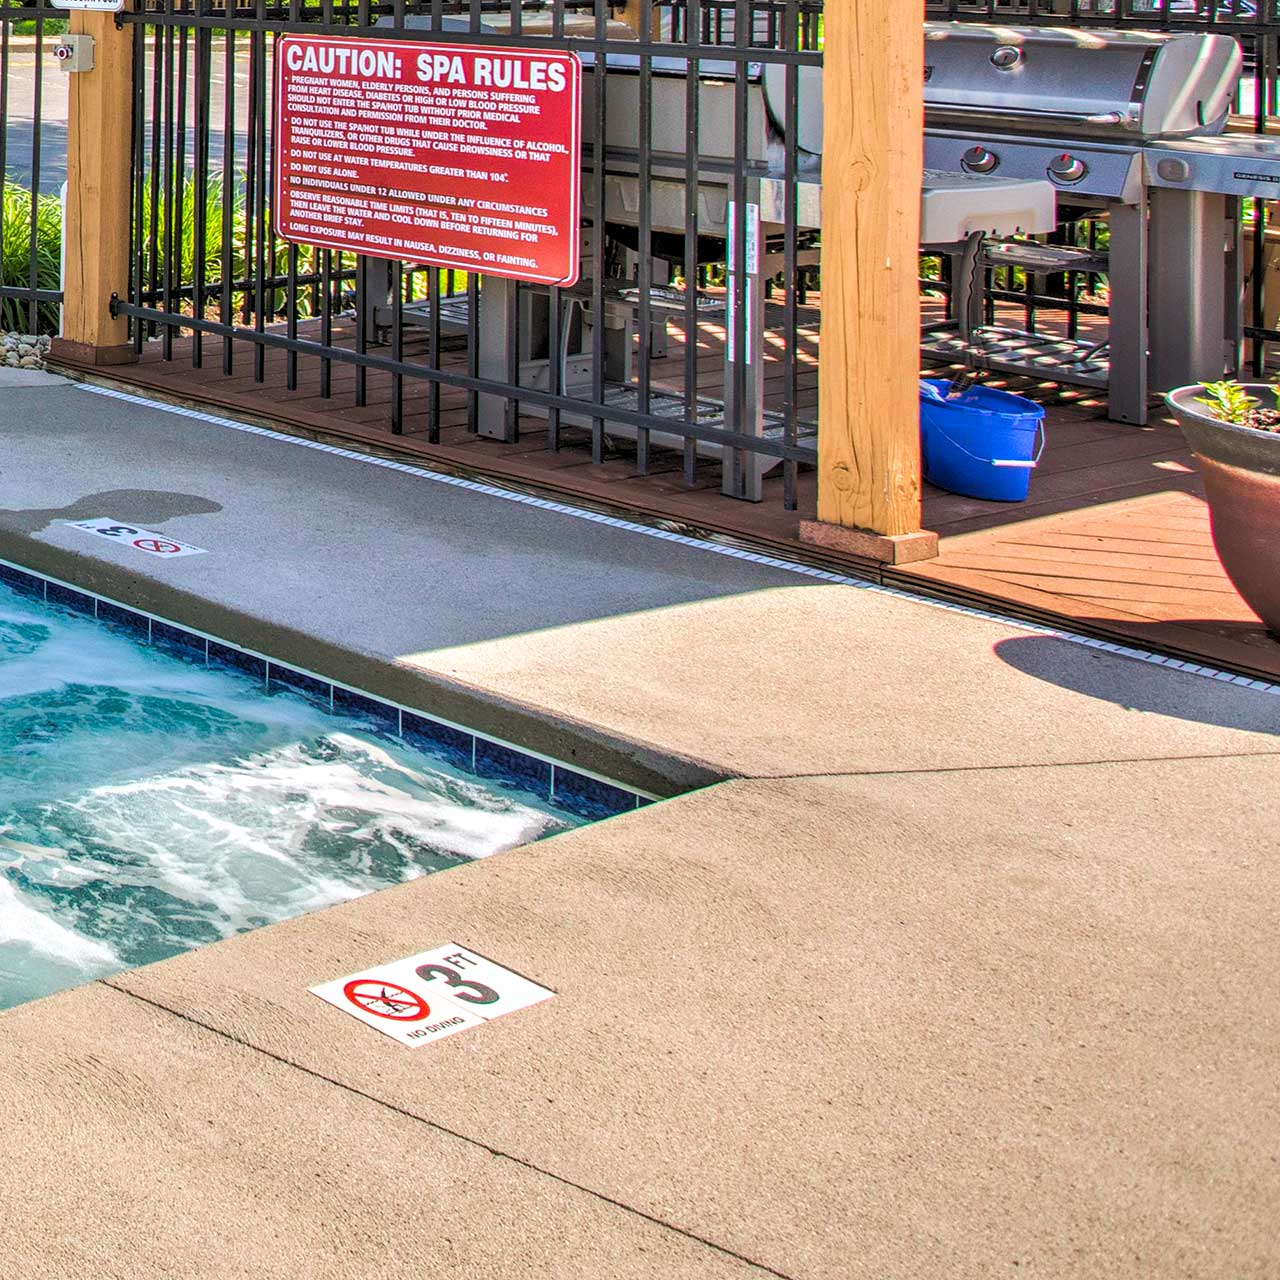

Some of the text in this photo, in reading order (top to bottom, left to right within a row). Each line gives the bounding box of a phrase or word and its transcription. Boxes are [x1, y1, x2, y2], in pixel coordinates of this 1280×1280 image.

[287, 45, 566, 92] CAUTION: SPA RULES
[288, 85, 307, 93] FROM
[310, 87, 331, 95] HEART
[333, 89, 364, 99] DISEASE,
[366, 92, 400, 101] DIABETES
[415, 96, 433, 104] HIGH
[436, 98, 447, 106] OR
[449, 99, 466, 107] LOW
[469, 101, 496, 110] BLOOD
[498, 103, 540, 114] PRESSURE
[292, 76, 535, 103] PREGNANT WOMEN, ELDERLY PERSONS, AND PERSONS SUFFERING
[288, 95, 315, 103] SHOULD
[317, 97, 331, 105] NOT
[333, 99, 355, 107] ENTER
[372, 102, 403, 111] SPA/HOT
[405, 105, 419, 113] TUB
[421, 106, 456, 116] WITHOUT
[458, 110, 481, 119] PRIOR
[483, 112, 520, 122] MEDICAL
[288, 104, 488, 130] CONSULTATION AND PERMISSION FROM THEIR DOCTOR.
[291, 127, 345, 141] TRANQUILIZERS,
[359, 134, 383, 143] OTHER
[385, 136, 410, 146] DRUGS
[412, 139, 431, 148] THAT
[433, 141, 458, 151] CAUSE
[460, 144, 513, 157] DROWSINESS
[515, 150, 527, 159] OR
[529, 151, 550, 161] THAT
[291, 136, 415, 156] RAISE OR LOWER BLOOD PRESSURE.
[319, 120, 332, 128] USE
[335, 122, 347, 130] THE
[349, 123, 378, 133] SPA/HOT
[381, 127, 395, 135] TUB
[397, 128, 420, 137] WHILE
[422, 131, 448, 140] UNDER
[450, 133, 465, 142] THE
[467, 135, 511, 147] INFLUENCE
[513, 140, 525, 148] OF
[526, 141, 568, 154] ALCOHOL,
[291, 163, 359, 178] DO NOT USE ALONE.
[303, 151, 317, 159] NOT
[319, 153, 331, 161] USE
[333, 154, 343, 162] AT
[344, 155, 368, 165] WATER
[370, 158, 427, 172] TEMPERATURES
[429, 165, 464, 177] GREATER
[466, 169, 488, 180] THAN
[290, 176, 548, 217] NO INDIVIDUALS UNDER 12 ALLOWED UNDER ANY CIRCUMSTANCES
[290, 191, 558, 235] OBSERVE REASONABLE TIME LIMITS (THAT IS, TEN TO FIFTEEN MINUTES).
[290, 210, 364, 227] ANOTHER BRIEF STAY.
[290, 200, 537, 242] THEN LEAVE THE WATER AND COOL DOWN BEFORE RETURNING FOR
[290, 222, 538, 268] LONG EXPOSURE MAY RESULT IN NAUSEA, DIZZINESS, OR FAINTING.
[97, 526, 138, 536] 3
[415, 953, 500, 1005] 3 FT
[407, 1016, 465, 1040] NO DIVING
